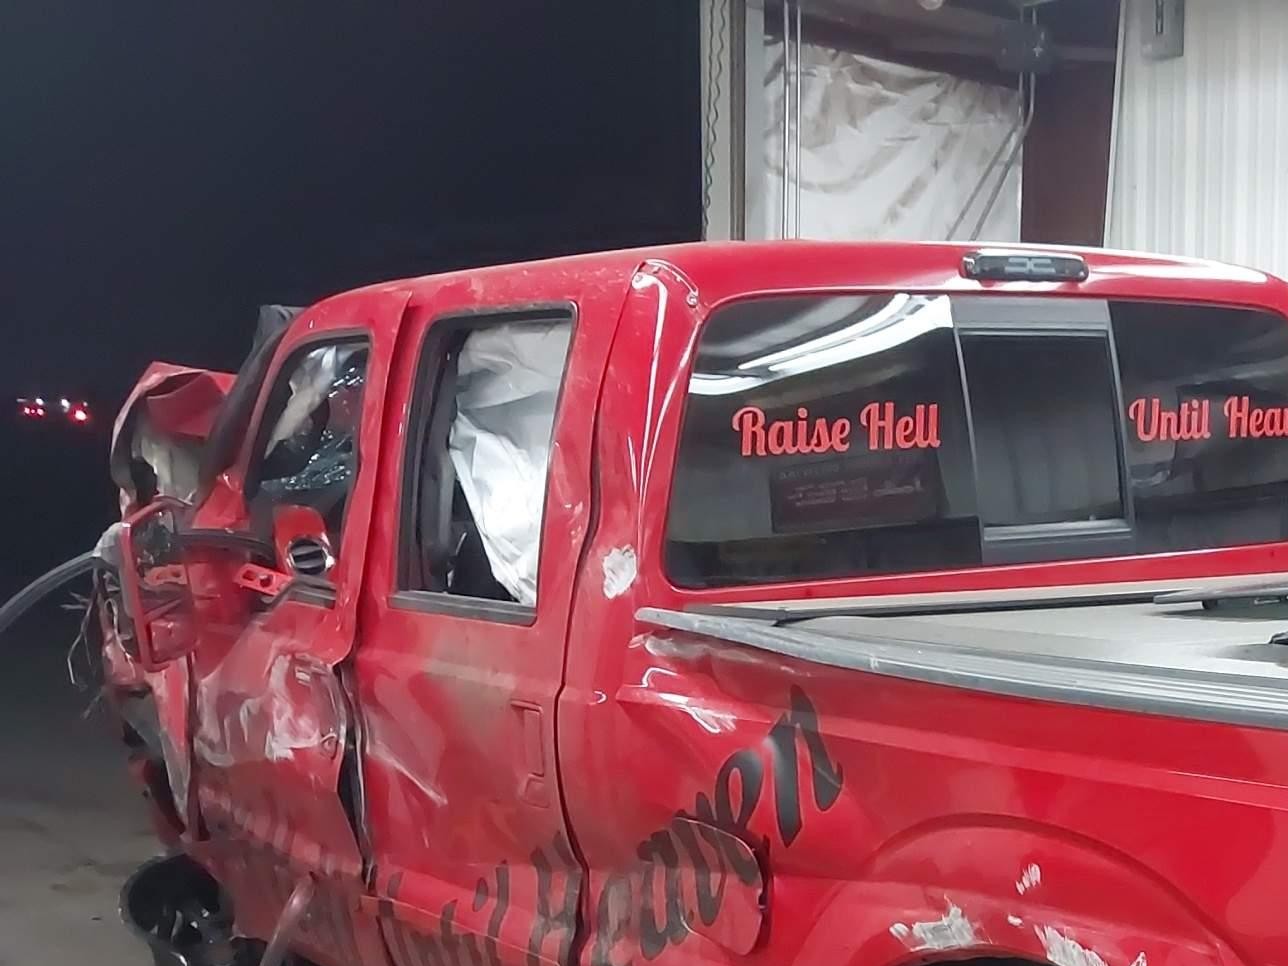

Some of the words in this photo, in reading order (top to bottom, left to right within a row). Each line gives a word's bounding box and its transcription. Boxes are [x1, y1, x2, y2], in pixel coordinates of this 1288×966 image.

[732, 406, 850, 457] Raise
[859, 401, 941, 450] Hell
[1128, 398, 1211, 442] Until
